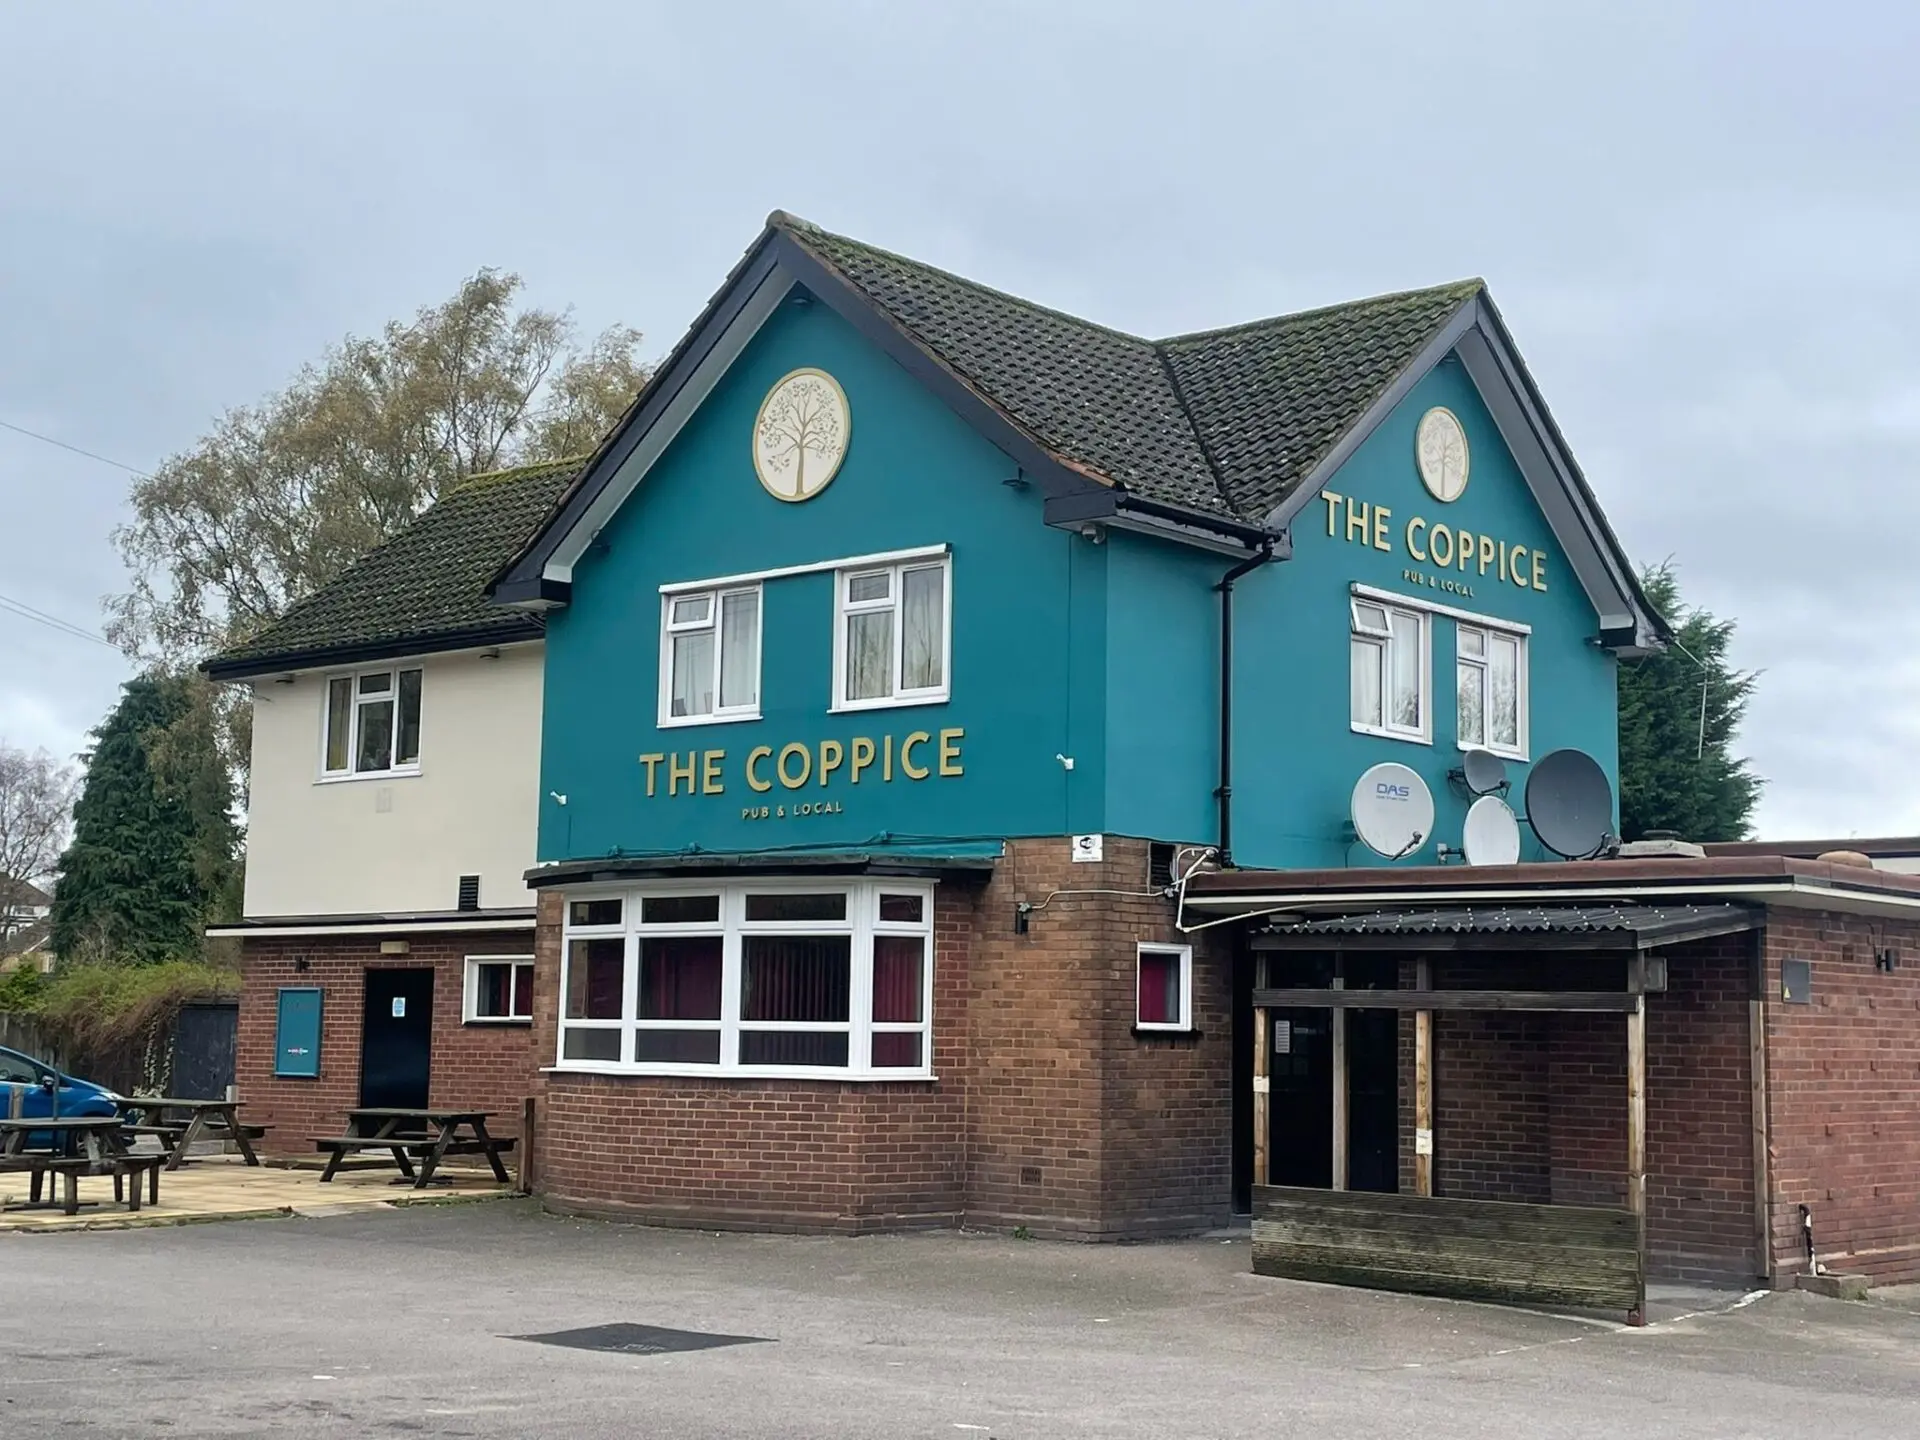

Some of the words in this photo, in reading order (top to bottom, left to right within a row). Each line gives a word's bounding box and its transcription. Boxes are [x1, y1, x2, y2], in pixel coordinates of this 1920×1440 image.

[1321, 490, 1392, 552] THE
[1406, 516, 1549, 592] COPPICE
[1403, 569, 1424, 584] PUB
[1428, 576, 1436, 588] &
[1440, 579, 1475, 598] LOCAL
[639, 749, 726, 796] THE
[745, 728, 965, 792] COPPICE
[1376, 783, 1410, 797] DAS
[742, 806, 769, 819] PUB
[777, 805, 785, 817] &
[793, 801, 842, 816] LOCAL
